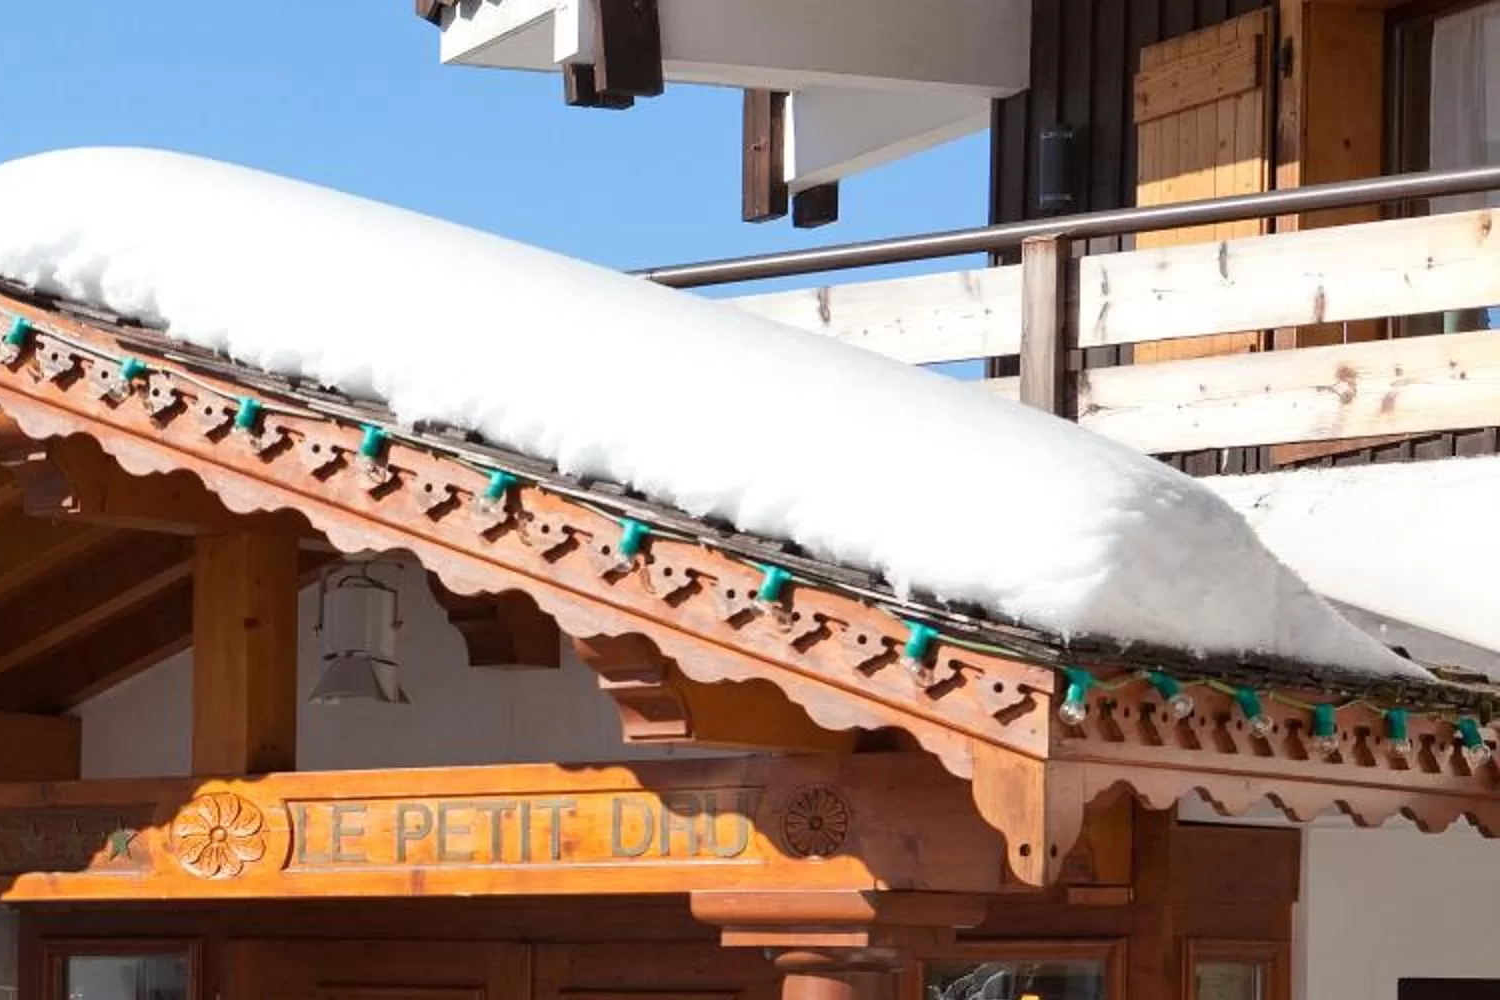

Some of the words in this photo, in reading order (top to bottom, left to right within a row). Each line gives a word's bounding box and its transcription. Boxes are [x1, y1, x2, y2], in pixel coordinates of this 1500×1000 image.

[297, 801, 367, 864] LE
[396, 797, 577, 862] PETIT
[612, 791, 750, 858] DRU
